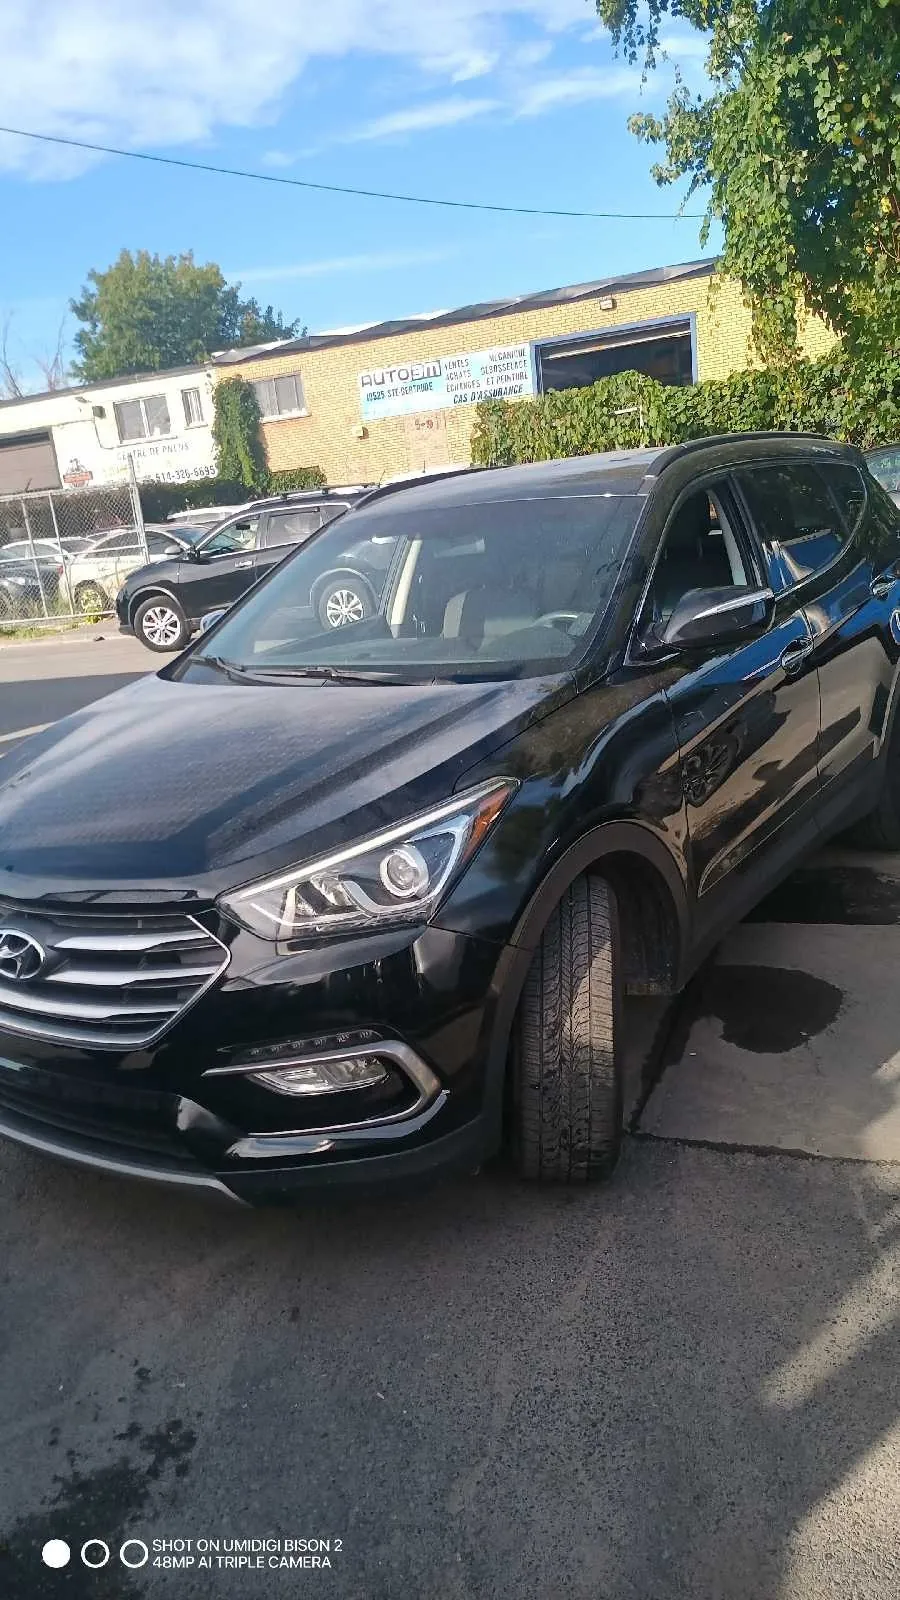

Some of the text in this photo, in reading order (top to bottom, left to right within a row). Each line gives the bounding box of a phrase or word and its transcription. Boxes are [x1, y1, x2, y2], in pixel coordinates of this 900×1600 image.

[444, 358, 469, 371] VENTES
[445, 369, 472, 381] ACHATS
[486, 371, 529, 386] ET PEINTURE
[366, 391, 385, 402] 10525
[453, 384, 524, 404] CAS D'ASSURANCE
[149, 446, 160, 456] DE
